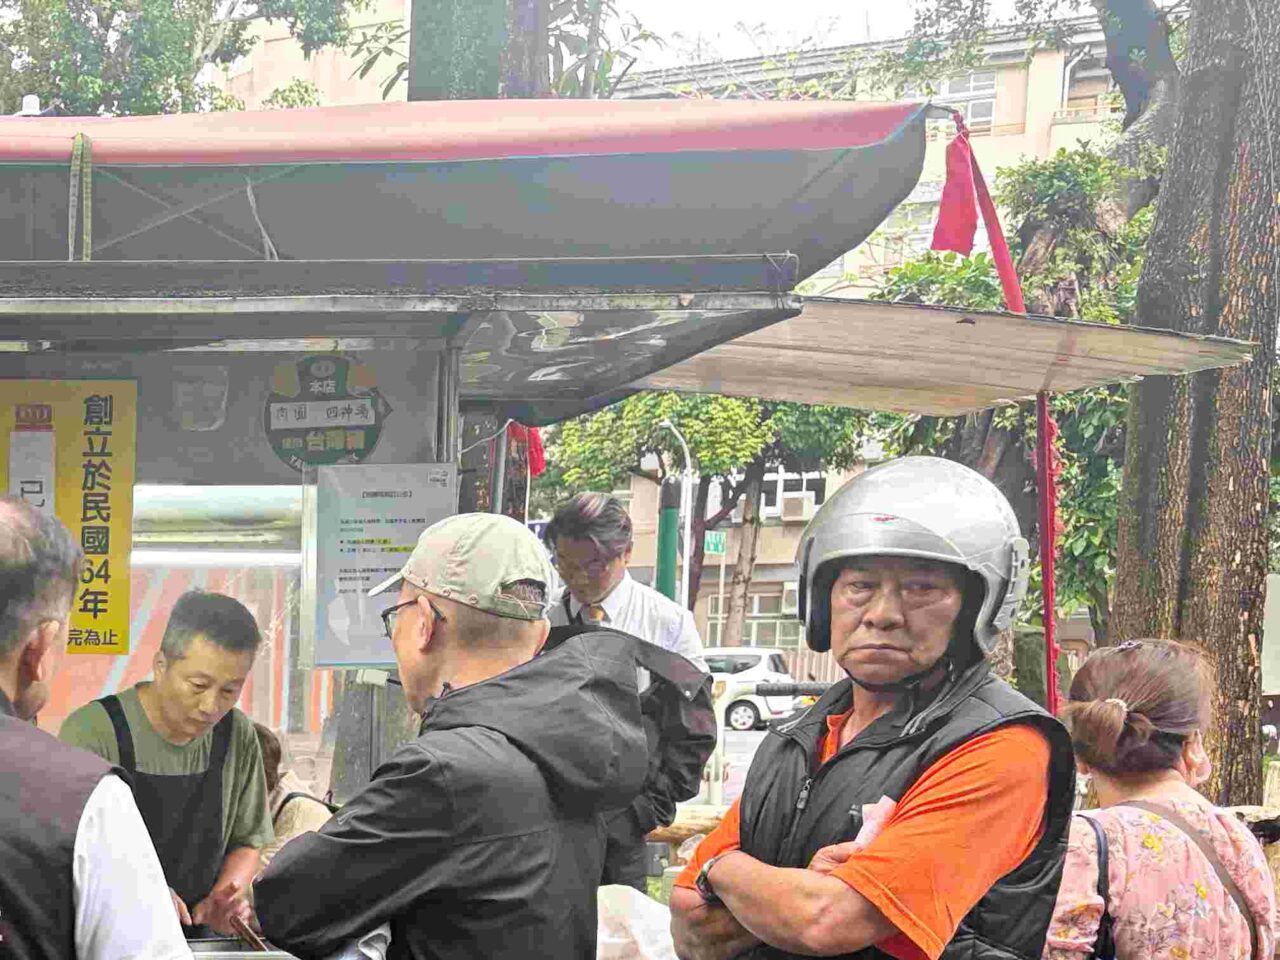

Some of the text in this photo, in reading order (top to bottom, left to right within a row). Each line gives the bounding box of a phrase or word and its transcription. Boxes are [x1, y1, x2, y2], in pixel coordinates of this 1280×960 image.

[79, 394, 114, 619] 創立於民國64年
